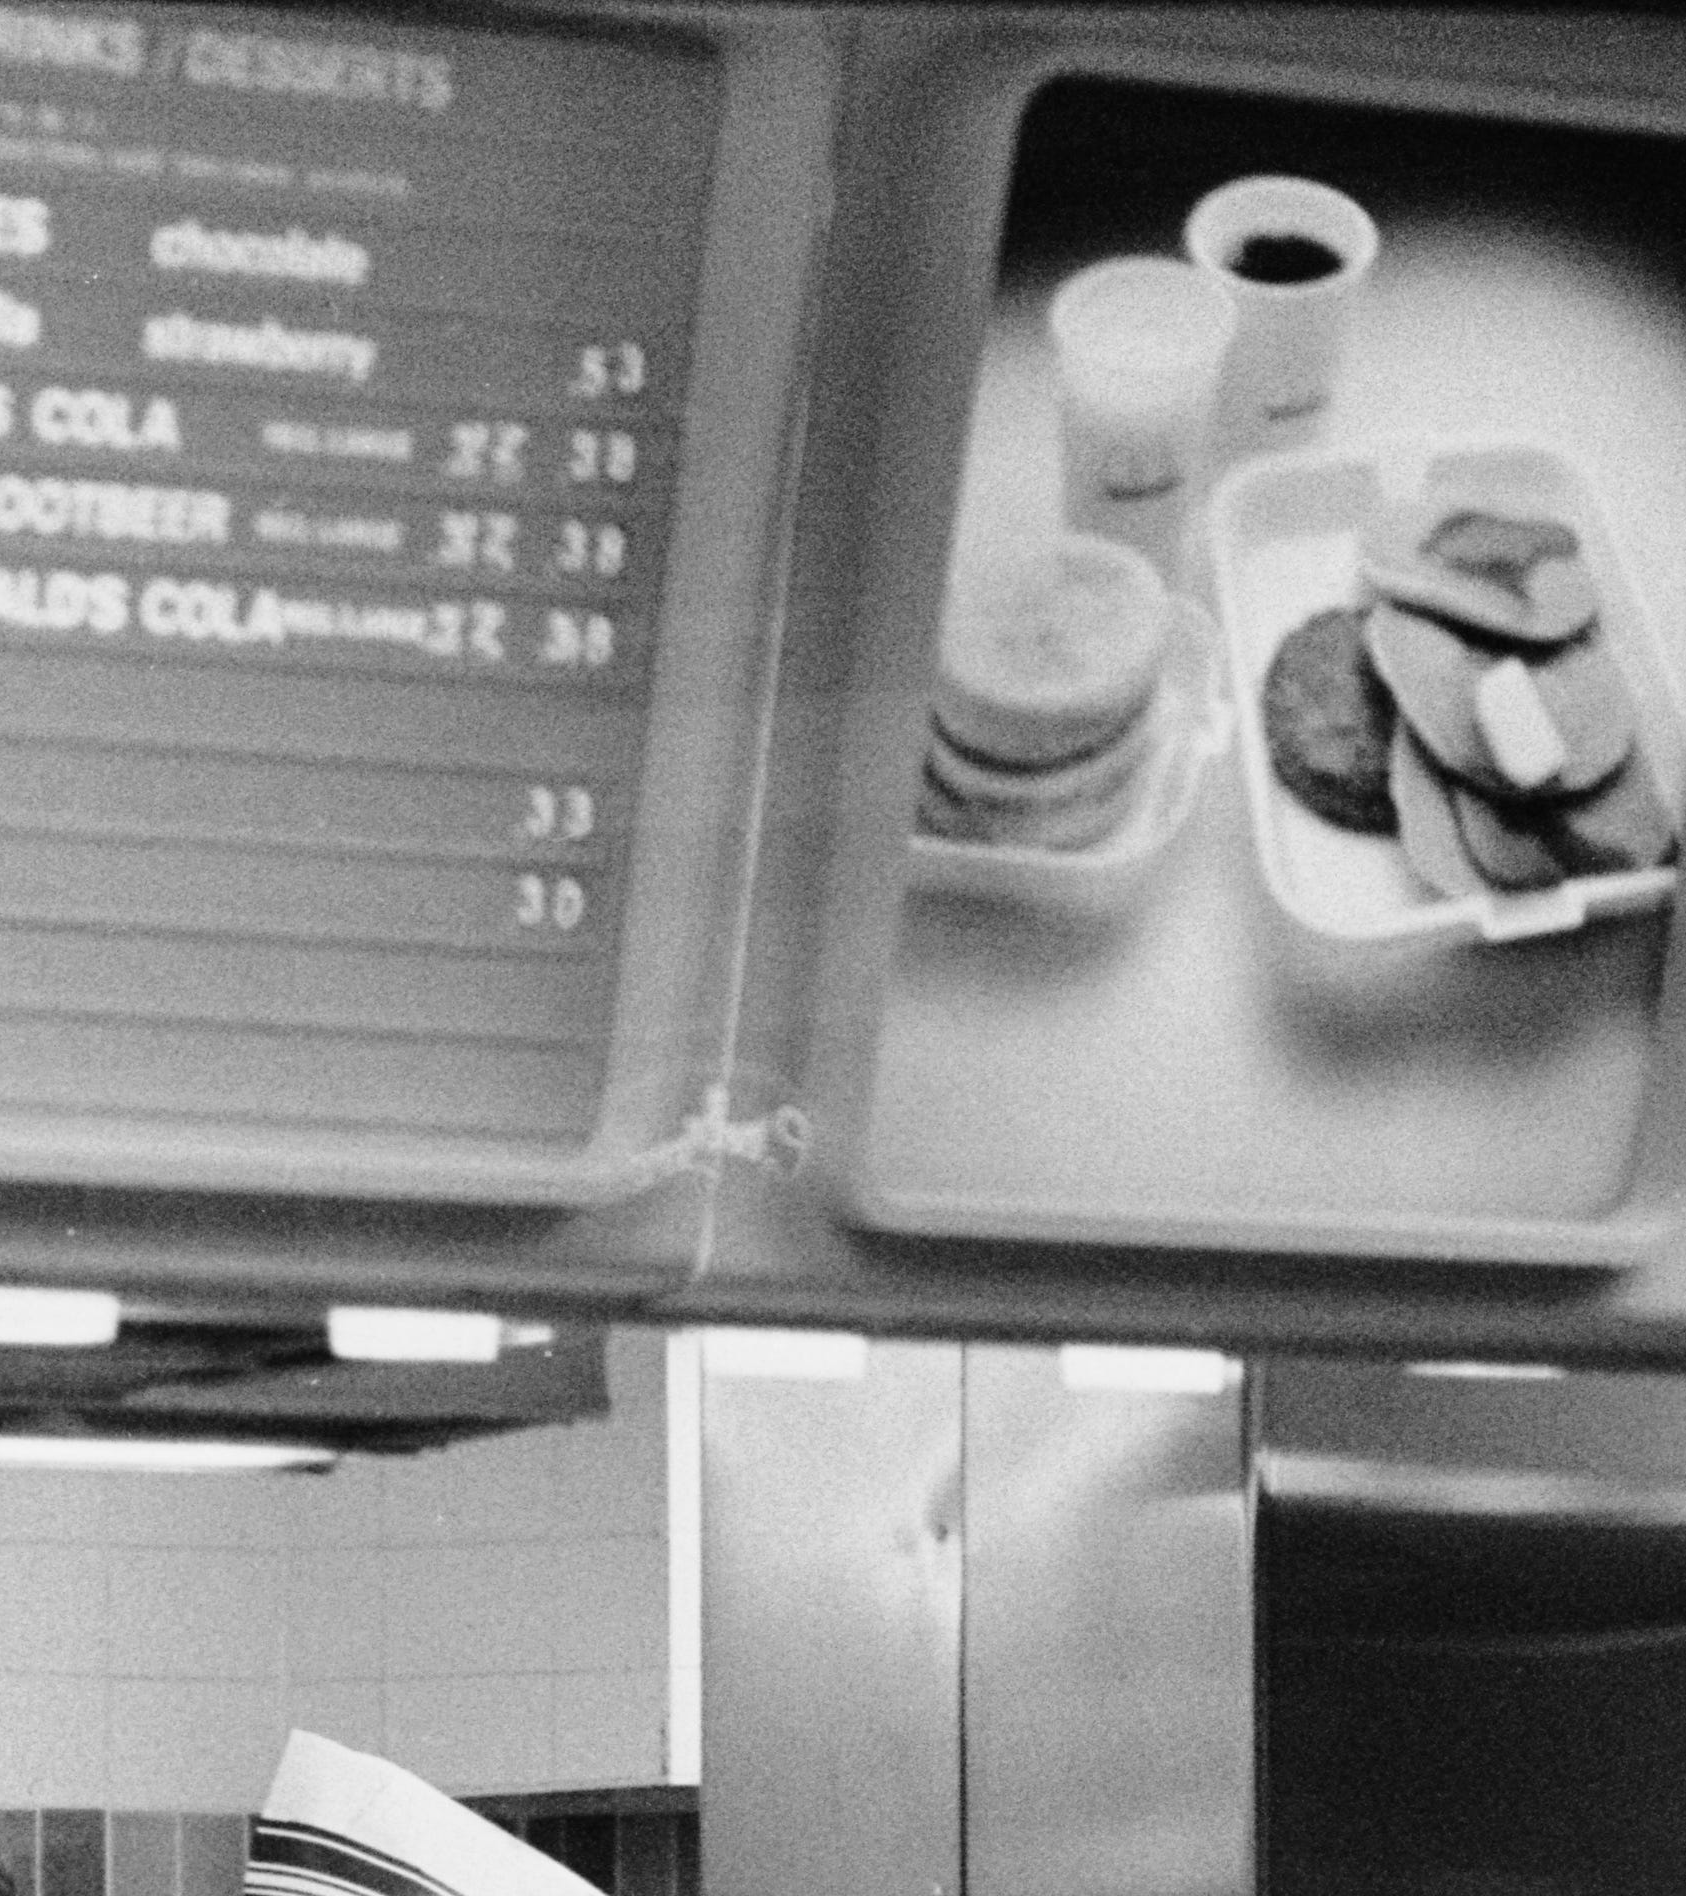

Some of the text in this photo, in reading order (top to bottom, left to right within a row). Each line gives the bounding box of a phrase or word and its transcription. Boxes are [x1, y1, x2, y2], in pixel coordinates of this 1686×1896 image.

[149, 218, 371, 284] chocolate
[143, 312, 376, 383] strawberry
[32, 384, 181, 450] COLA
[139, 577, 284, 645] COLA
